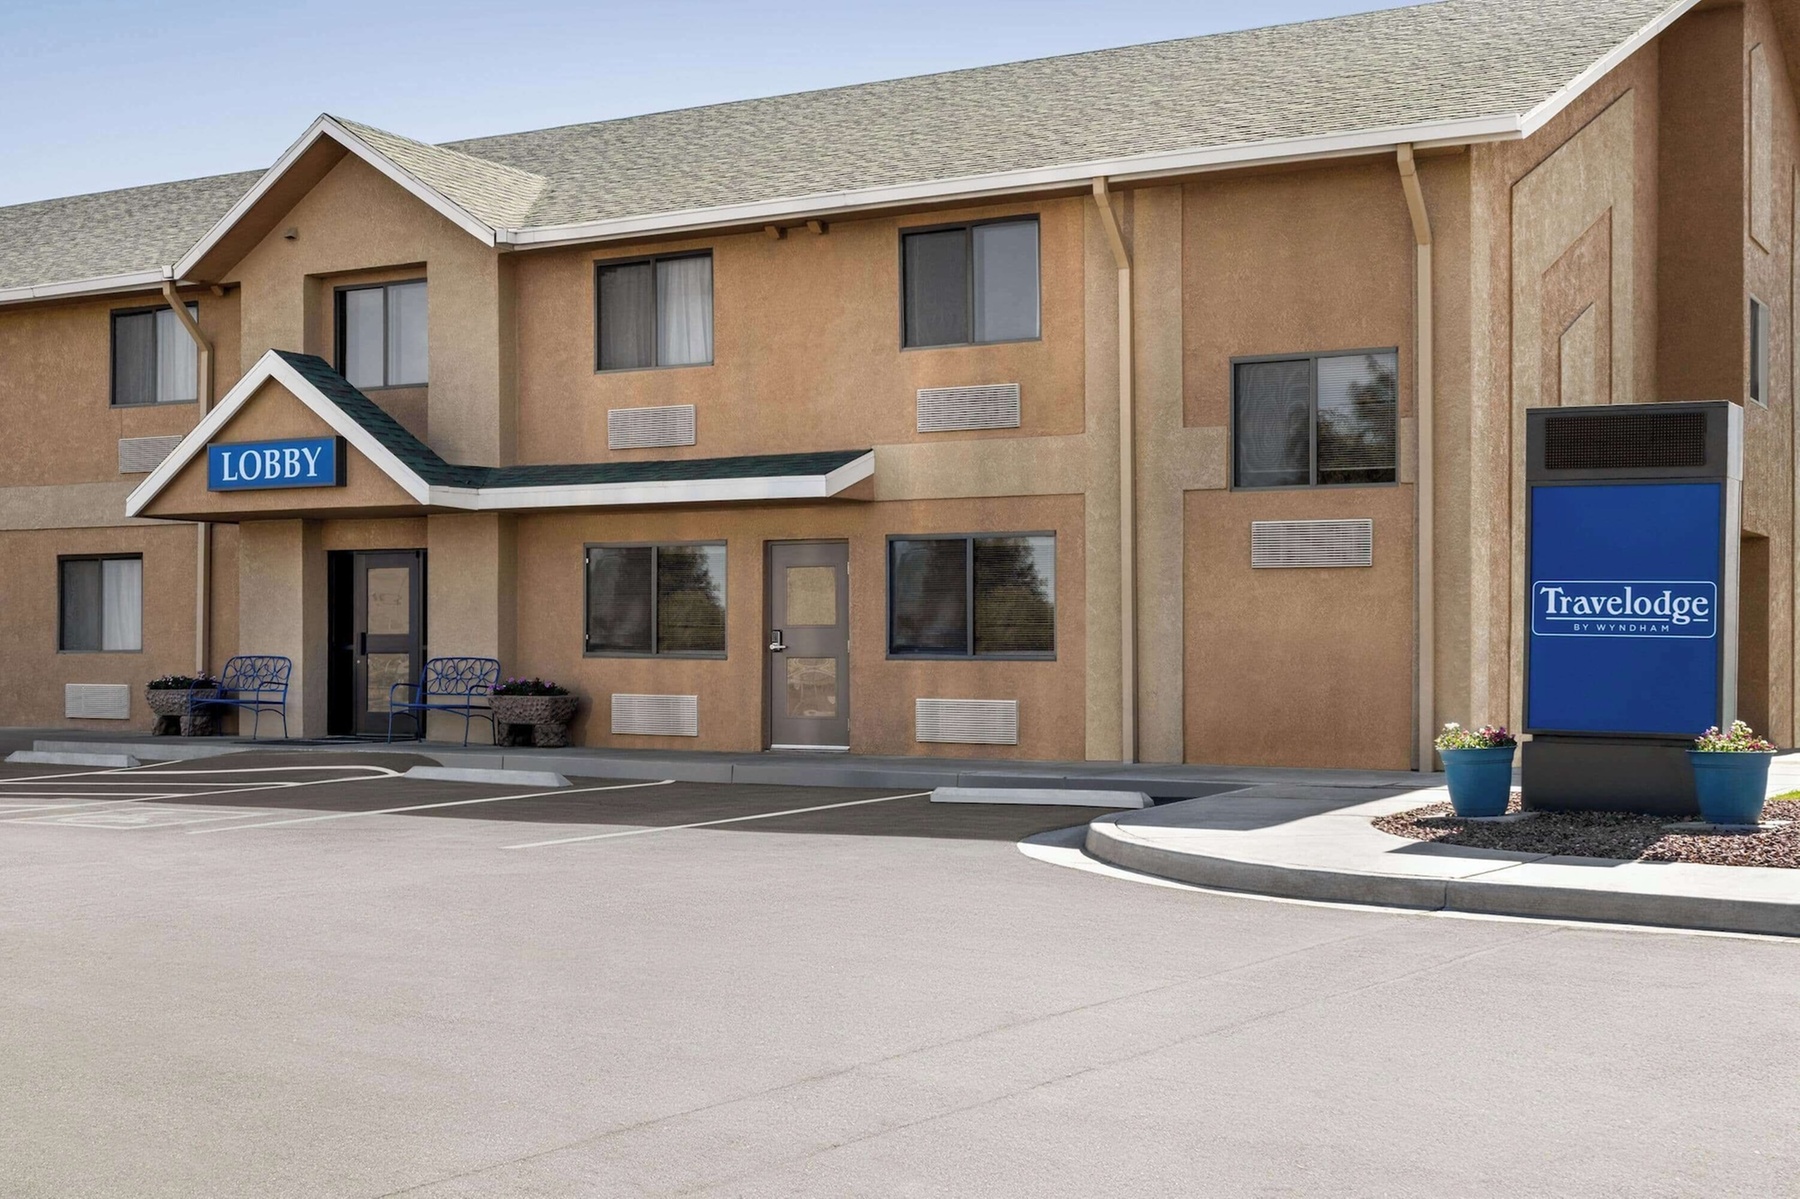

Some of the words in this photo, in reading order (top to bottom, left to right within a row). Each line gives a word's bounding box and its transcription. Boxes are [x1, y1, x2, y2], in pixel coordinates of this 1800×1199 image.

[221, 446, 322, 482] LOBBY
[1539, 586, 1710, 625] Travelodge
[1573, 623, 1590, 631] BY
[1597, 623, 1670, 632] WYNDHAM
